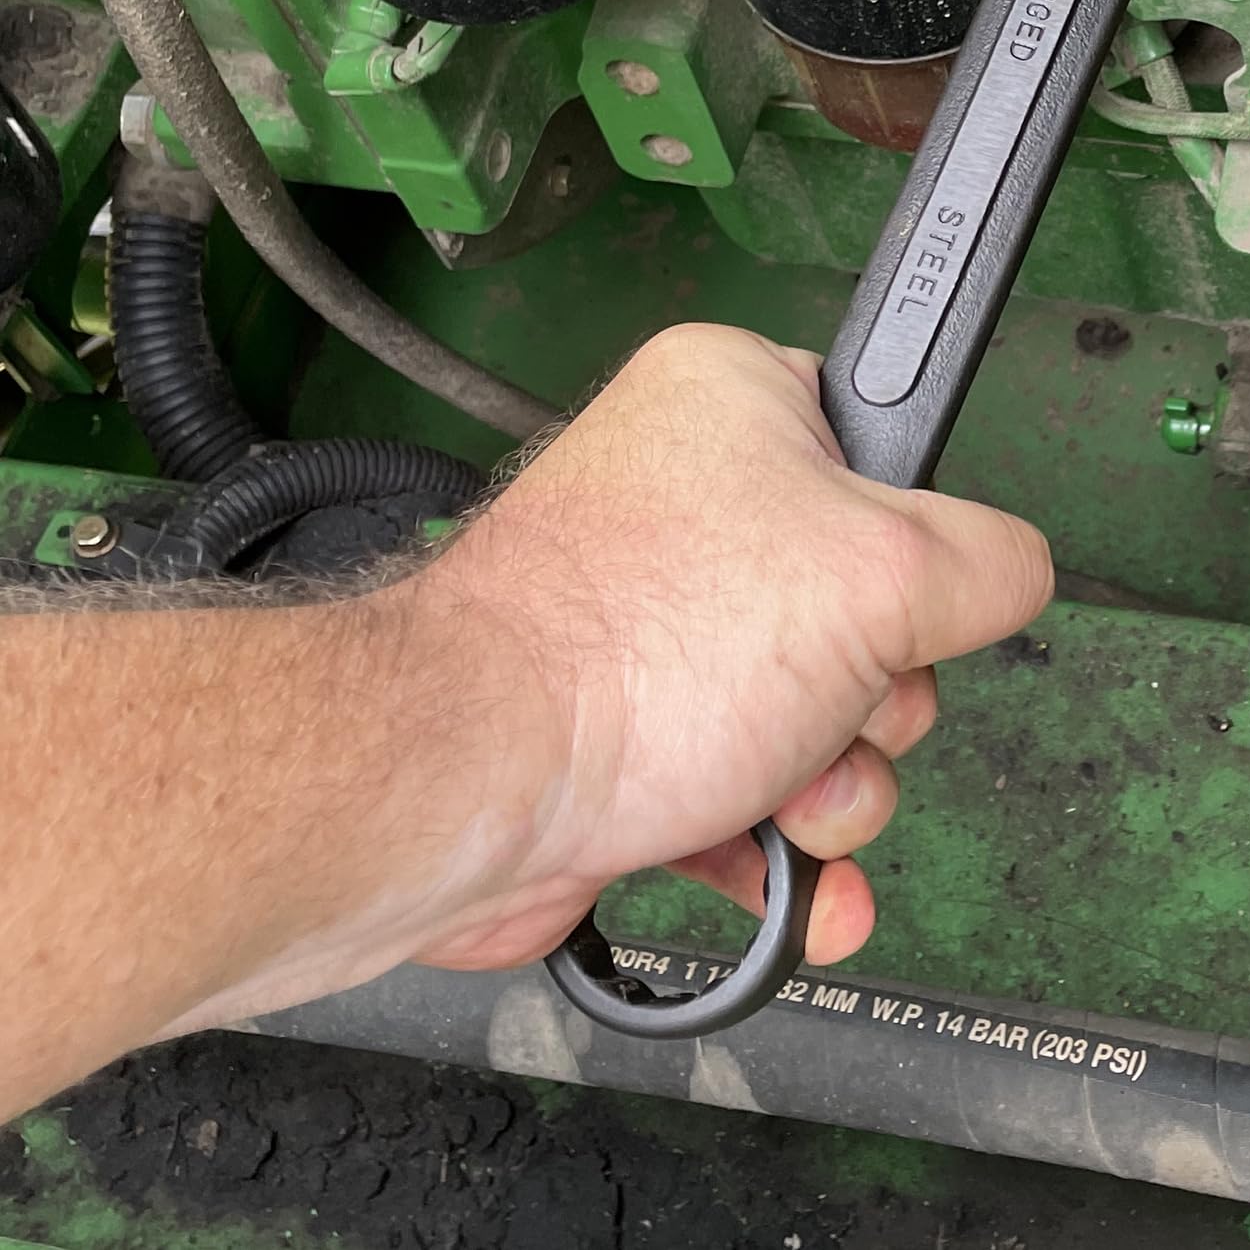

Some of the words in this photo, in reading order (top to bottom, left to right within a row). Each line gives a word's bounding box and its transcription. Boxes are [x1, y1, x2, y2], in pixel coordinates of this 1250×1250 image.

[897, 206, 966, 315] STEEL
[685, 961, 699, 980] 1
[811, 985, 860, 1014] MM
[871, 996, 925, 1030] W.P.
[935, 1011, 966, 1036] 14
[968, 1018, 1029, 1051] BAR
[1032, 1029, 1088, 1065] (203
[1091, 1043, 1147, 1082] PSI)
